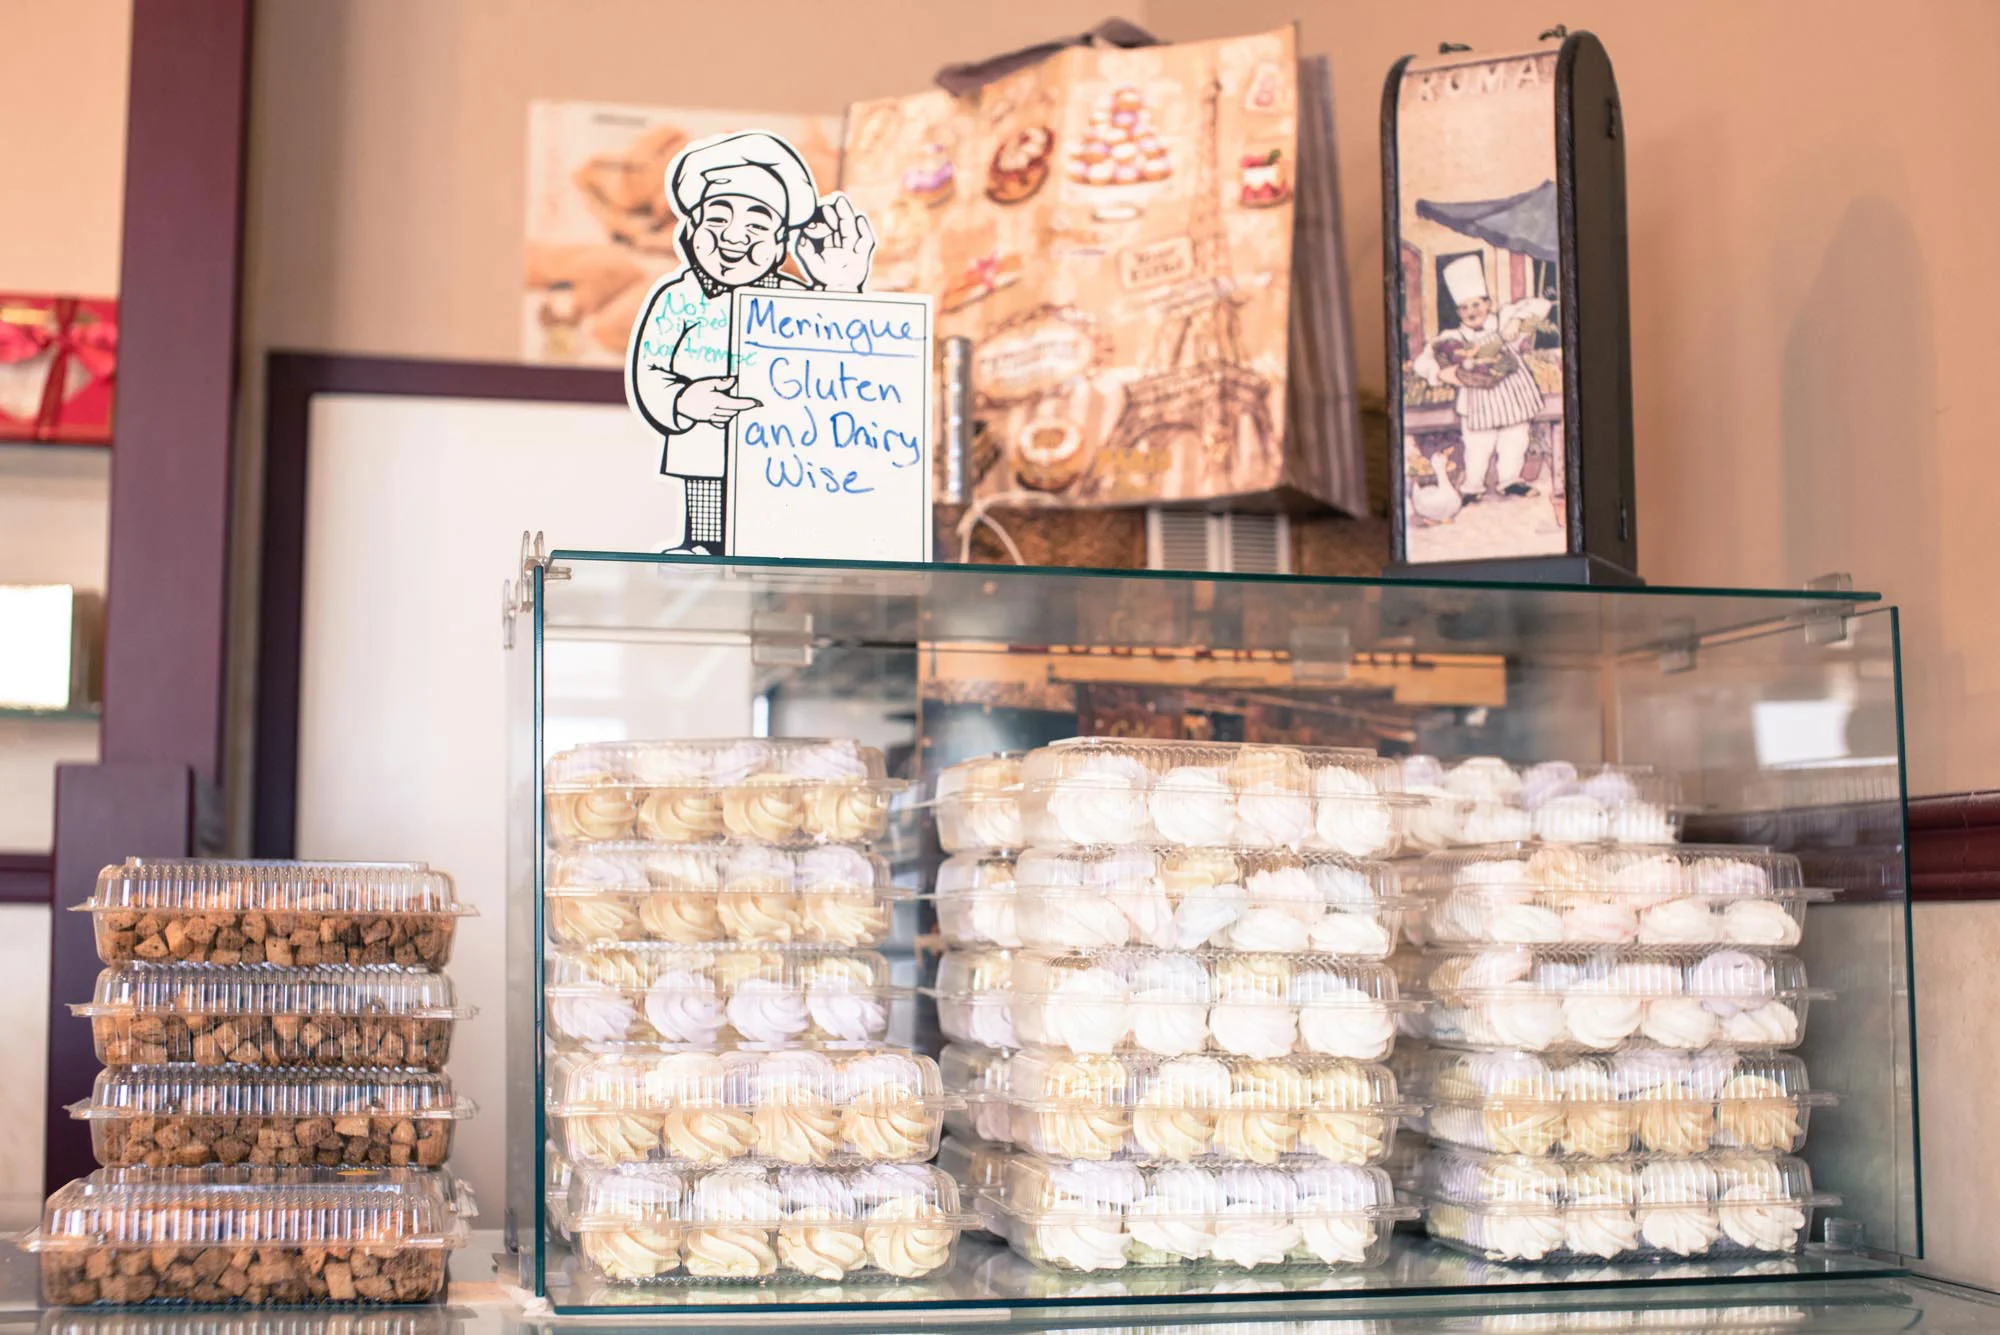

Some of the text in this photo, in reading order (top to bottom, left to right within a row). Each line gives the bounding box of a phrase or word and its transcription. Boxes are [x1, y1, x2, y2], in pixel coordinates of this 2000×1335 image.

[656, 309, 728, 338] Dipped
[659, 292, 710, 317] Not
[746, 297, 924, 356] Meringue
[769, 357, 901, 403] Gluten
[745, 406, 818, 449] and
[766, 454, 875, 494] Wise
